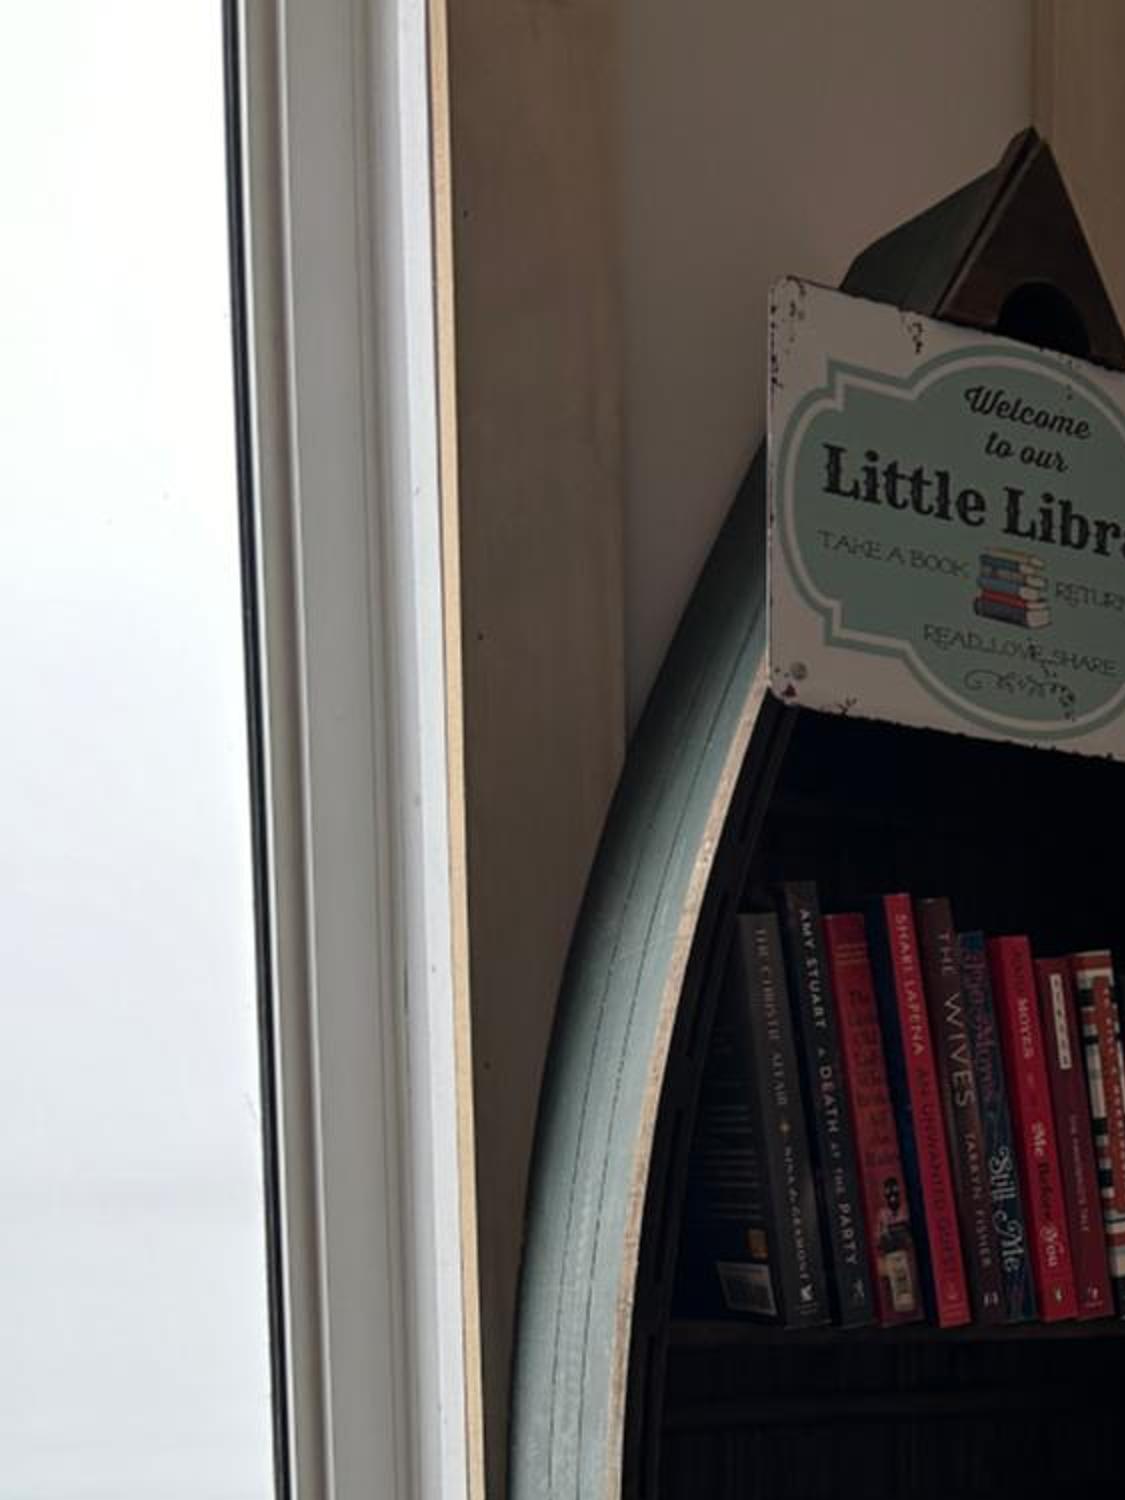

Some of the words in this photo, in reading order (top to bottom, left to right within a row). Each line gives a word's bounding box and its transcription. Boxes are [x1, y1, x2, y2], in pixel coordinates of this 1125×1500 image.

[964, 384, 1093, 440] Welcome
[985, 431, 1014, 460] to
[1020, 447, 1070, 474] our
[821, 443, 987, 527] Little
[817, 529, 883, 561] TAKE
[884, 545, 907, 566] A
[909, 549, 971, 579] BOOK
[798, 908, 816, 950] AMY
[893, 912, 915, 971] SHARI
[935, 929, 957, 976] THE
[805, 957, 826, 1028] STUART
[902, 979, 926, 1056] LAPENA
[941, 991, 976, 1107] WIVES
[819, 1065, 840, 1132] DEATH
[833, 1167, 845, 1195] THE
[986, 1145, 1017, 1201] Still
[837, 1202, 857, 1264] PARTY
[973, 1209, 993, 1267] FISHER
[990, 1208, 1027, 1274] Me
